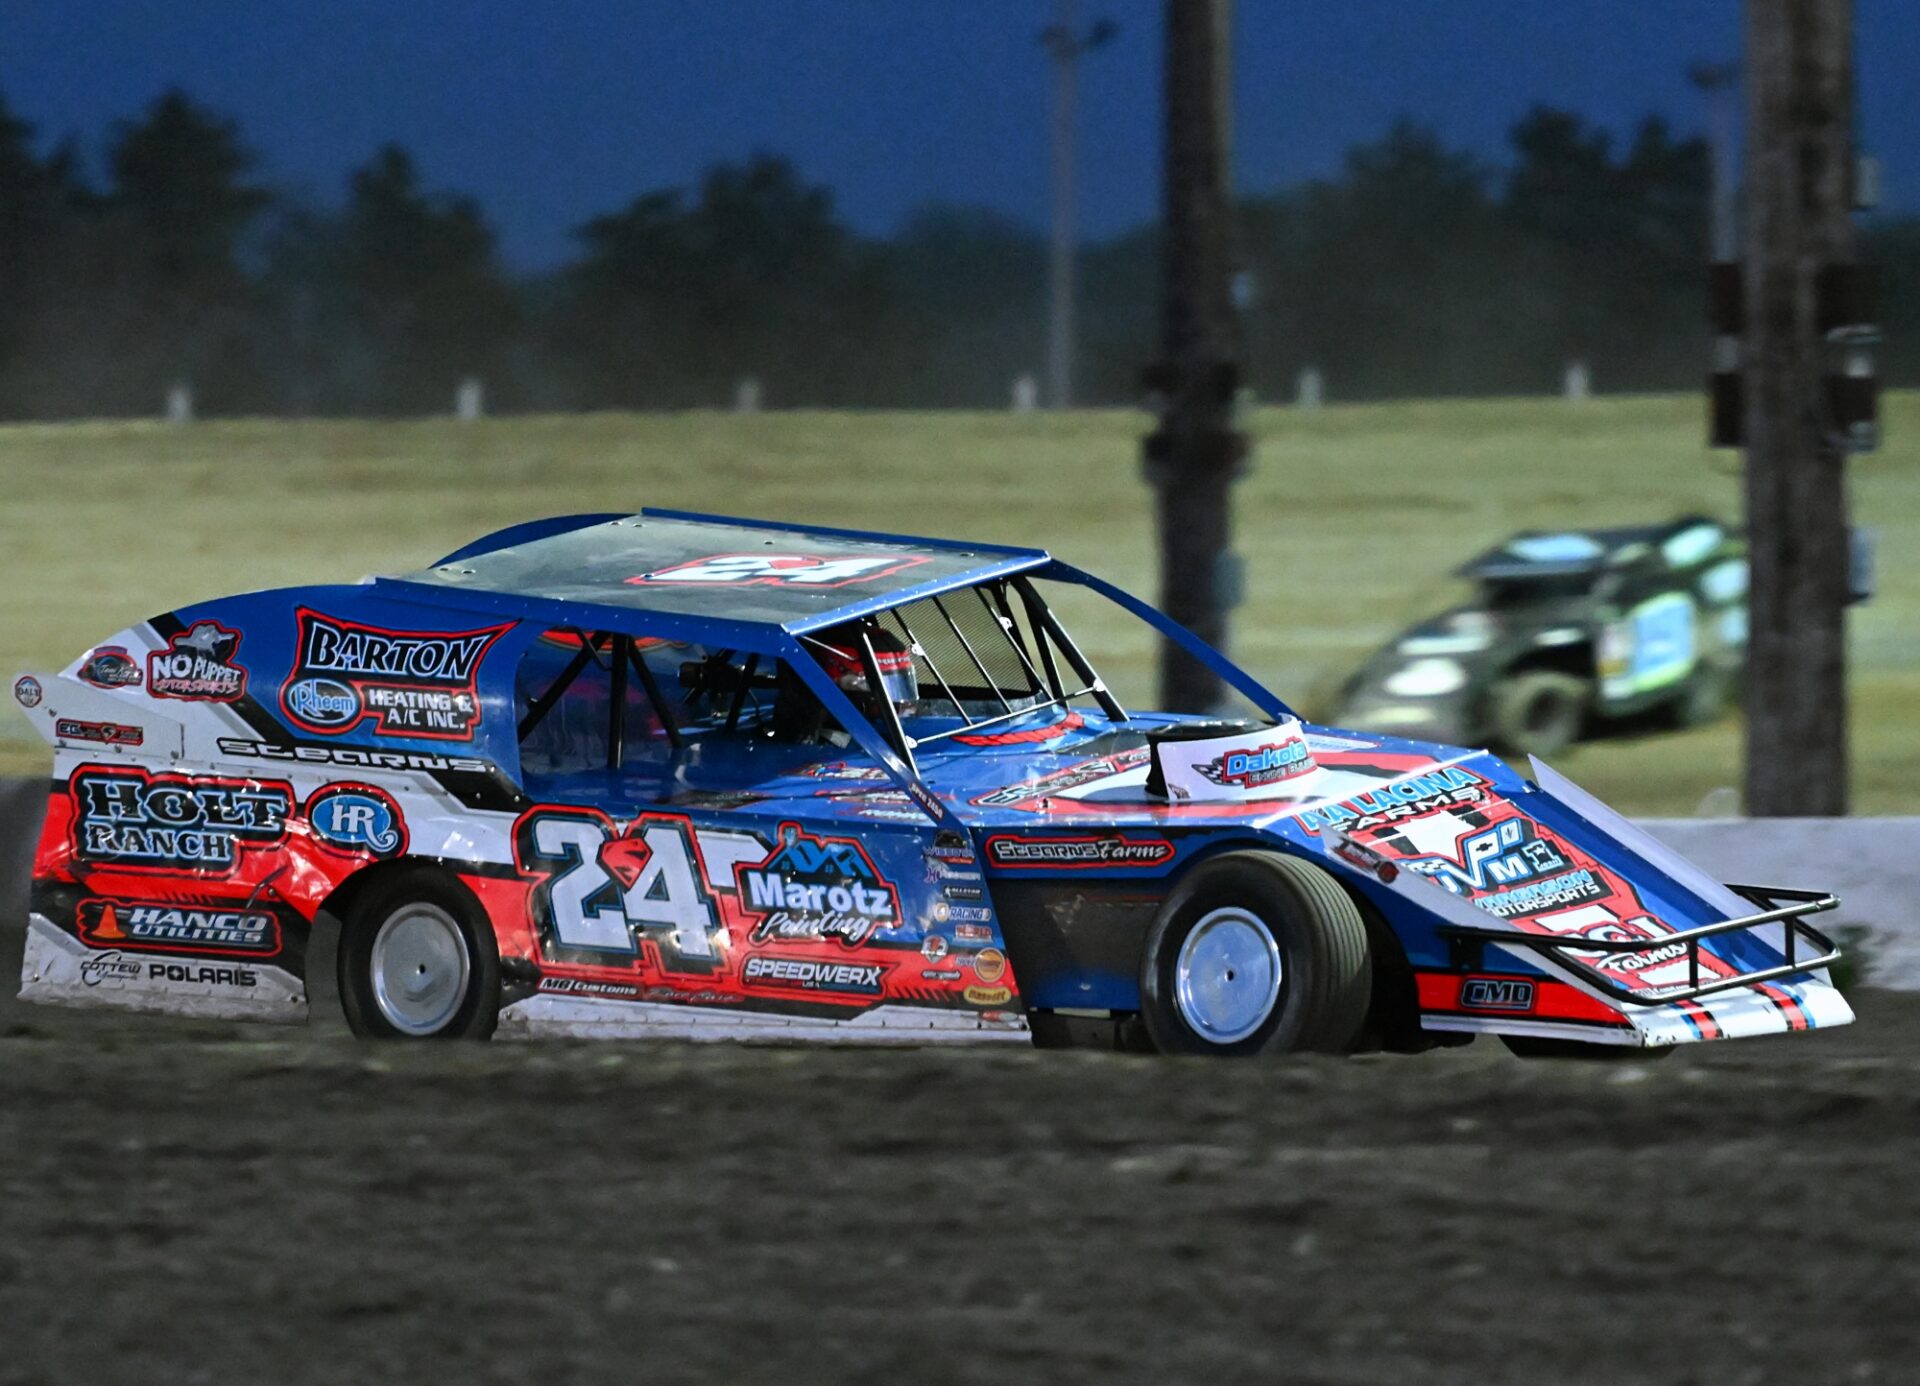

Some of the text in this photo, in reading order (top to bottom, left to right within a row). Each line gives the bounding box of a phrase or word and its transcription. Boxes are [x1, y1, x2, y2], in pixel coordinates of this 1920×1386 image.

[649, 556, 898, 582] 24
[306, 621, 493, 680] BARTON
[153, 654, 192, 680] NO
[193, 656, 241, 683] PUPPET
[295, 681, 354, 718] Rheem
[369, 689, 474, 713] HEATING &
[387, 709, 467, 729] A/C INC.
[1227, 740, 1308, 776] Dakota
[83, 778, 286, 831] HOLT
[85, 820, 232, 861] RANCH
[1098, 840, 1166, 860] Farms
[533, 817, 715, 958] 24
[747, 872, 892, 916] Marotz
[130, 907, 268, 931] HANCO
[132, 924, 263, 943] UTILITIES
[760, 910, 870, 941] Painting
[149, 963, 258, 988] POLARIS
[745, 958, 882, 987] SPEEDWERX
[574, 981, 638, 996] Customs
